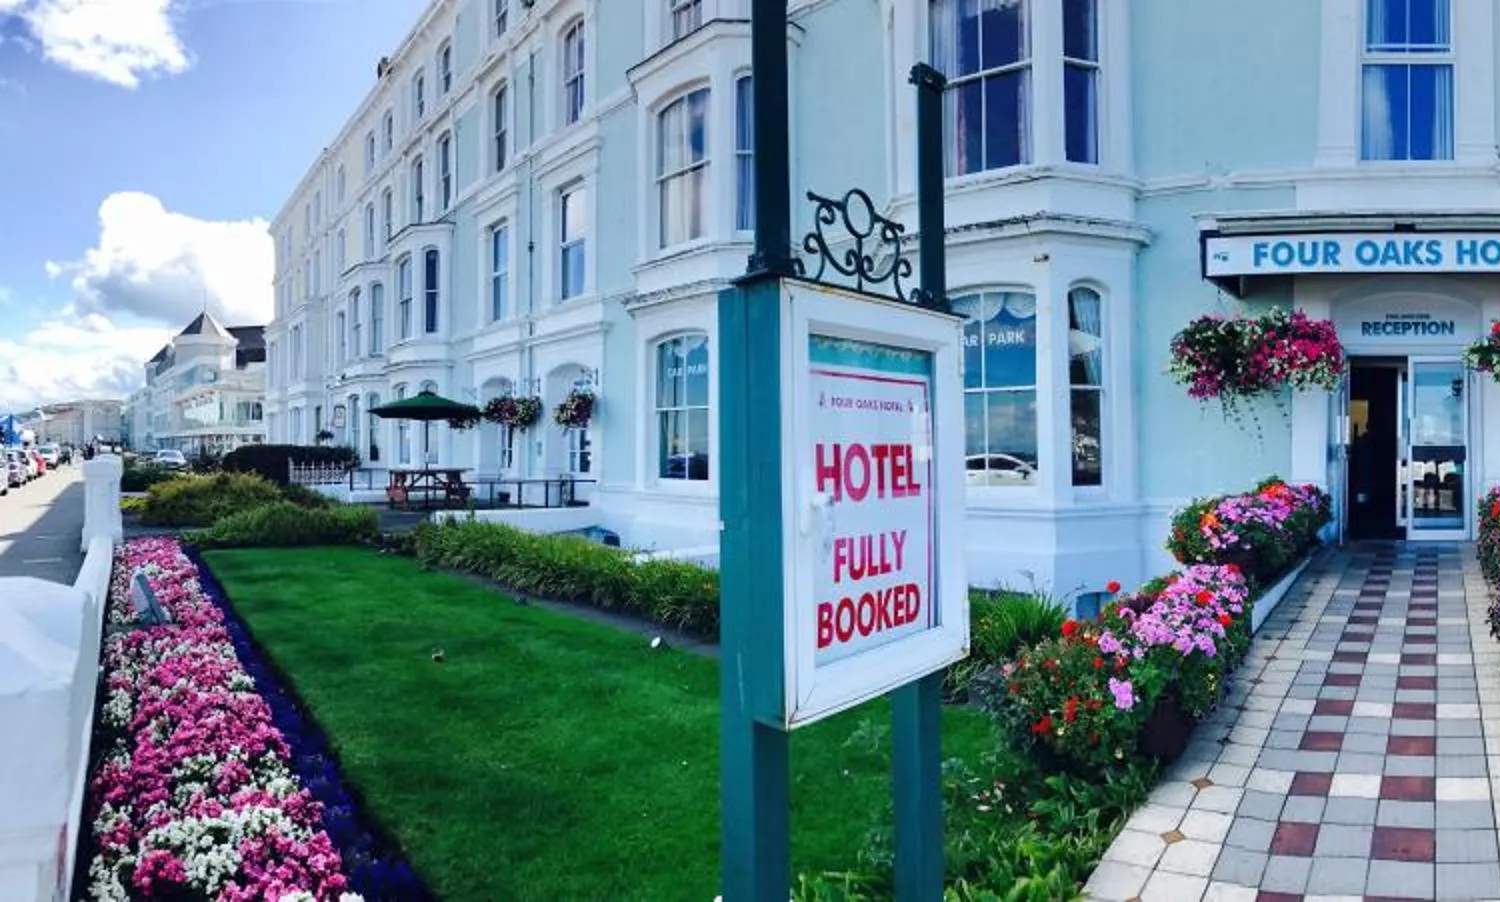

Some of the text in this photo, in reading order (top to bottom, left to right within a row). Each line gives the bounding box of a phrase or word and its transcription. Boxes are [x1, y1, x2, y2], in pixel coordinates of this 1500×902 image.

[1253, 240, 1341, 268] FOUR
[1355, 239, 1443, 267] OAKS
[960, 329, 1025, 347] AR PARK
[1361, 321, 1455, 336] RECEPTION
[831, 397, 853, 409] FOUR
[815, 443, 920, 502] HOTEL
[833, 529, 907, 583] FULLY
[817, 582, 921, 649] BOOKED
